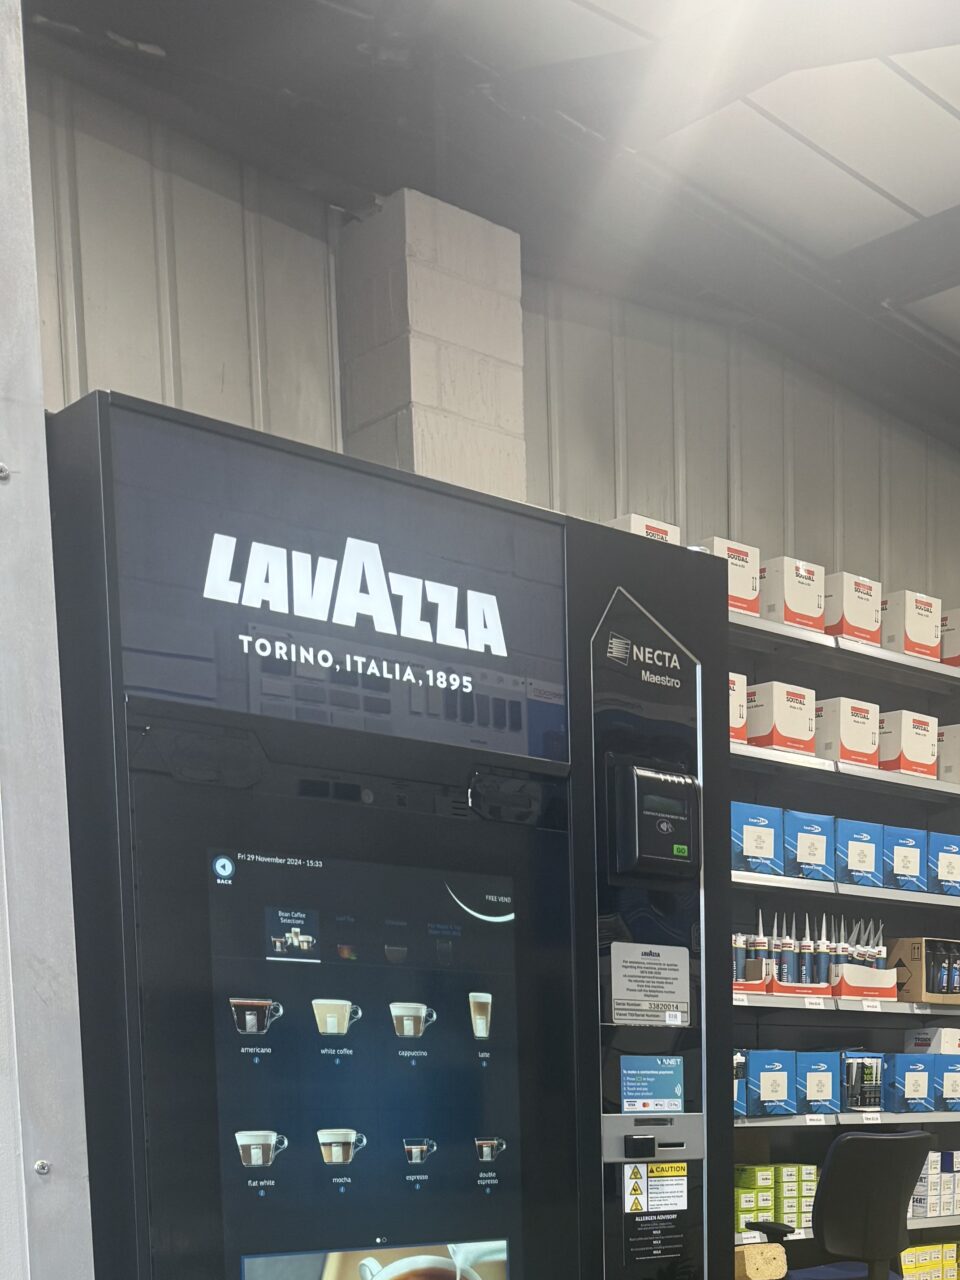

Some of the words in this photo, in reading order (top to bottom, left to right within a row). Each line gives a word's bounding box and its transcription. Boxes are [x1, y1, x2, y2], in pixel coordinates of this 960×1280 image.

[203, 533, 507, 657] LAVAZZA
[238, 634, 340, 671] TORINO,
[346, 654, 423, 686] ITALIA,
[426, 669, 473, 693] 1895
[632, 645, 681, 670] NECTA
[641, 670, 681, 688] Maestro
[676, 847, 687, 855] GO
[237, 853, 246, 861] Fri
[247, 854, 255, 862] 29
[255, 855, 286, 865] November
[286, 857, 302, 866] 2024
[306, 859, 323, 868] 15:33
[240, 1046, 272, 1054] americano
[336, 1048, 353, 1056] coffee
[332, 1176, 351, 1184] mocha
